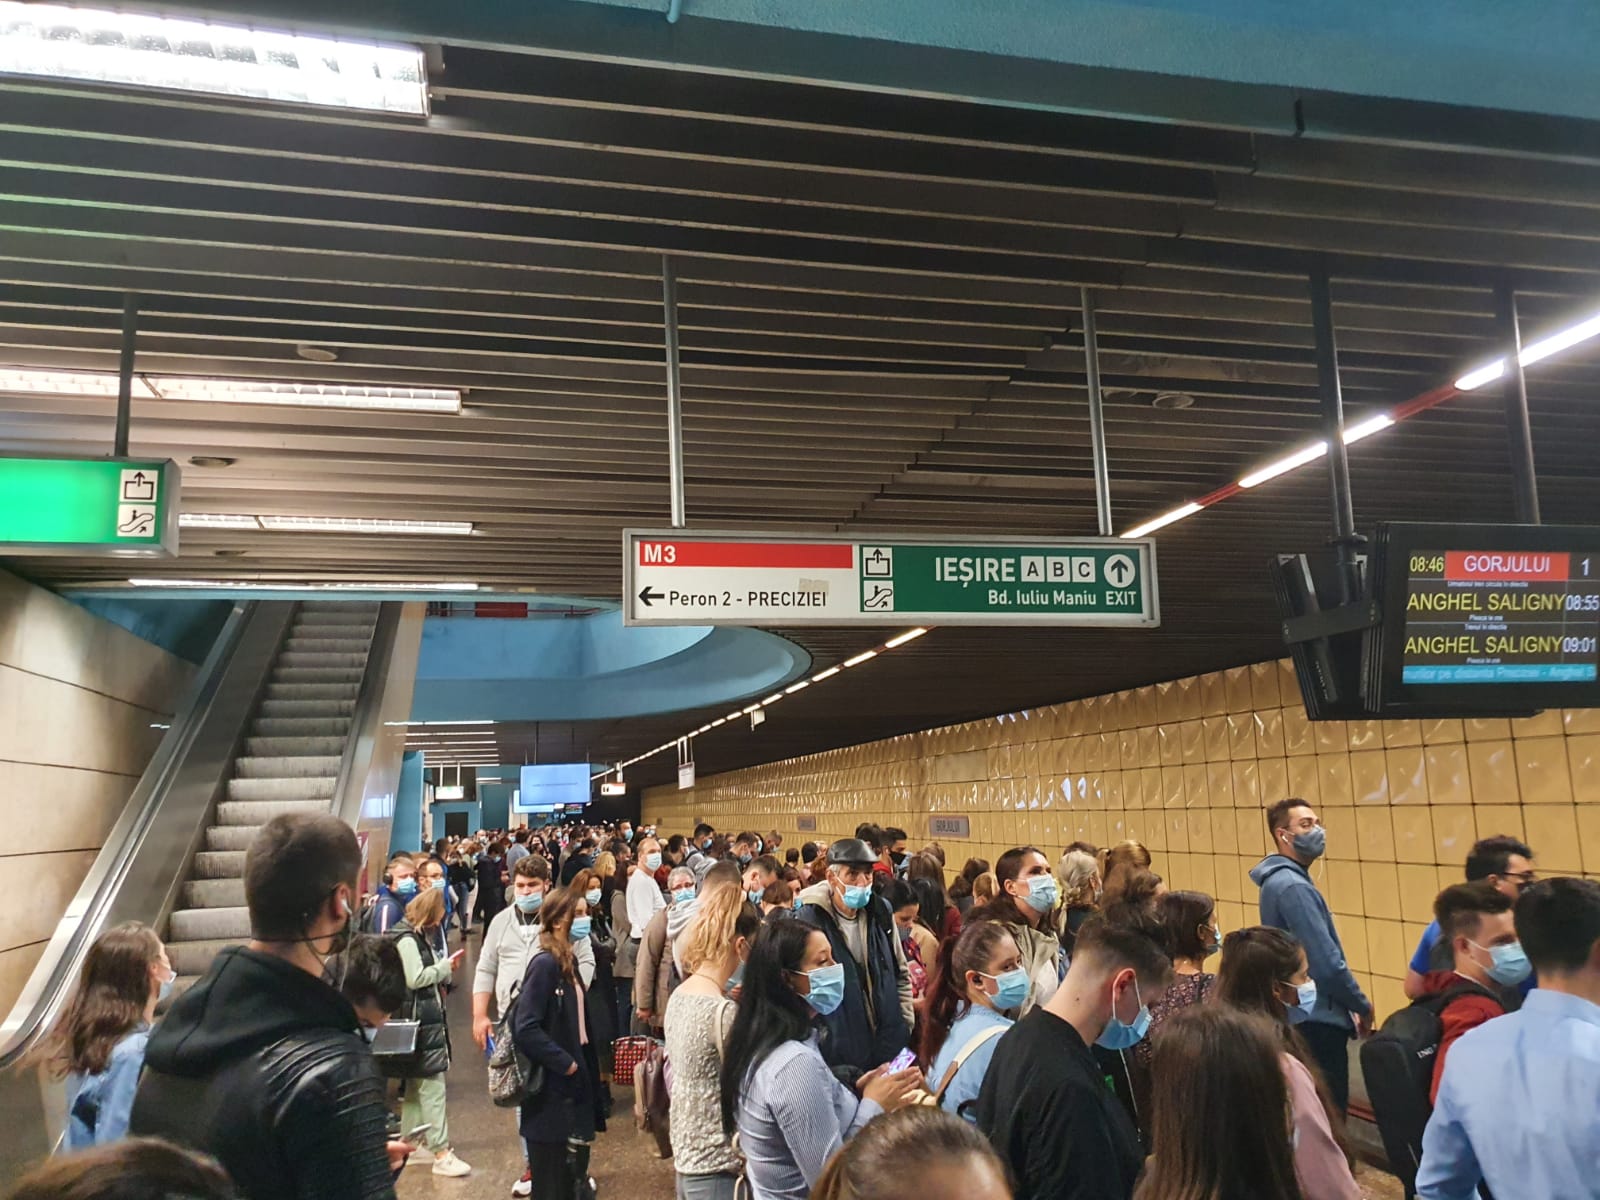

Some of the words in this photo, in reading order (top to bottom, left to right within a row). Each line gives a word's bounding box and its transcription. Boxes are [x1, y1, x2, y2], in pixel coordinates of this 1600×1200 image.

[644, 543, 677, 563] M3
[1026, 561, 1039, 577] A
[1053, 561, 1065, 577] B
[1078, 561, 1091, 578] C
[1409, 556, 1444, 573] 08:46
[1463, 554, 1550, 573] GORJULUI
[1581, 558, 1591, 576] 1
[669, 590, 717, 607] Peron
[722, 591, 732, 607] 2
[748, 591, 826, 607] PRECIZIEI
[988, 589, 1012, 605] Bd.
[1016, 589, 1049, 605] Iuliu
[1053, 590, 1097, 606] Maniu
[1105, 590, 1137, 606] EXIT
[1406, 593, 1482, 611] ANGHEL
[1487, 593, 1566, 611] SALIGNY
[1565, 595, 1600, 611] 08:55
[1404, 636, 1480, 654] ANGHEL
[1485, 636, 1564, 654] SALIGNY
[1562, 637, 1597, 653] 09:01
